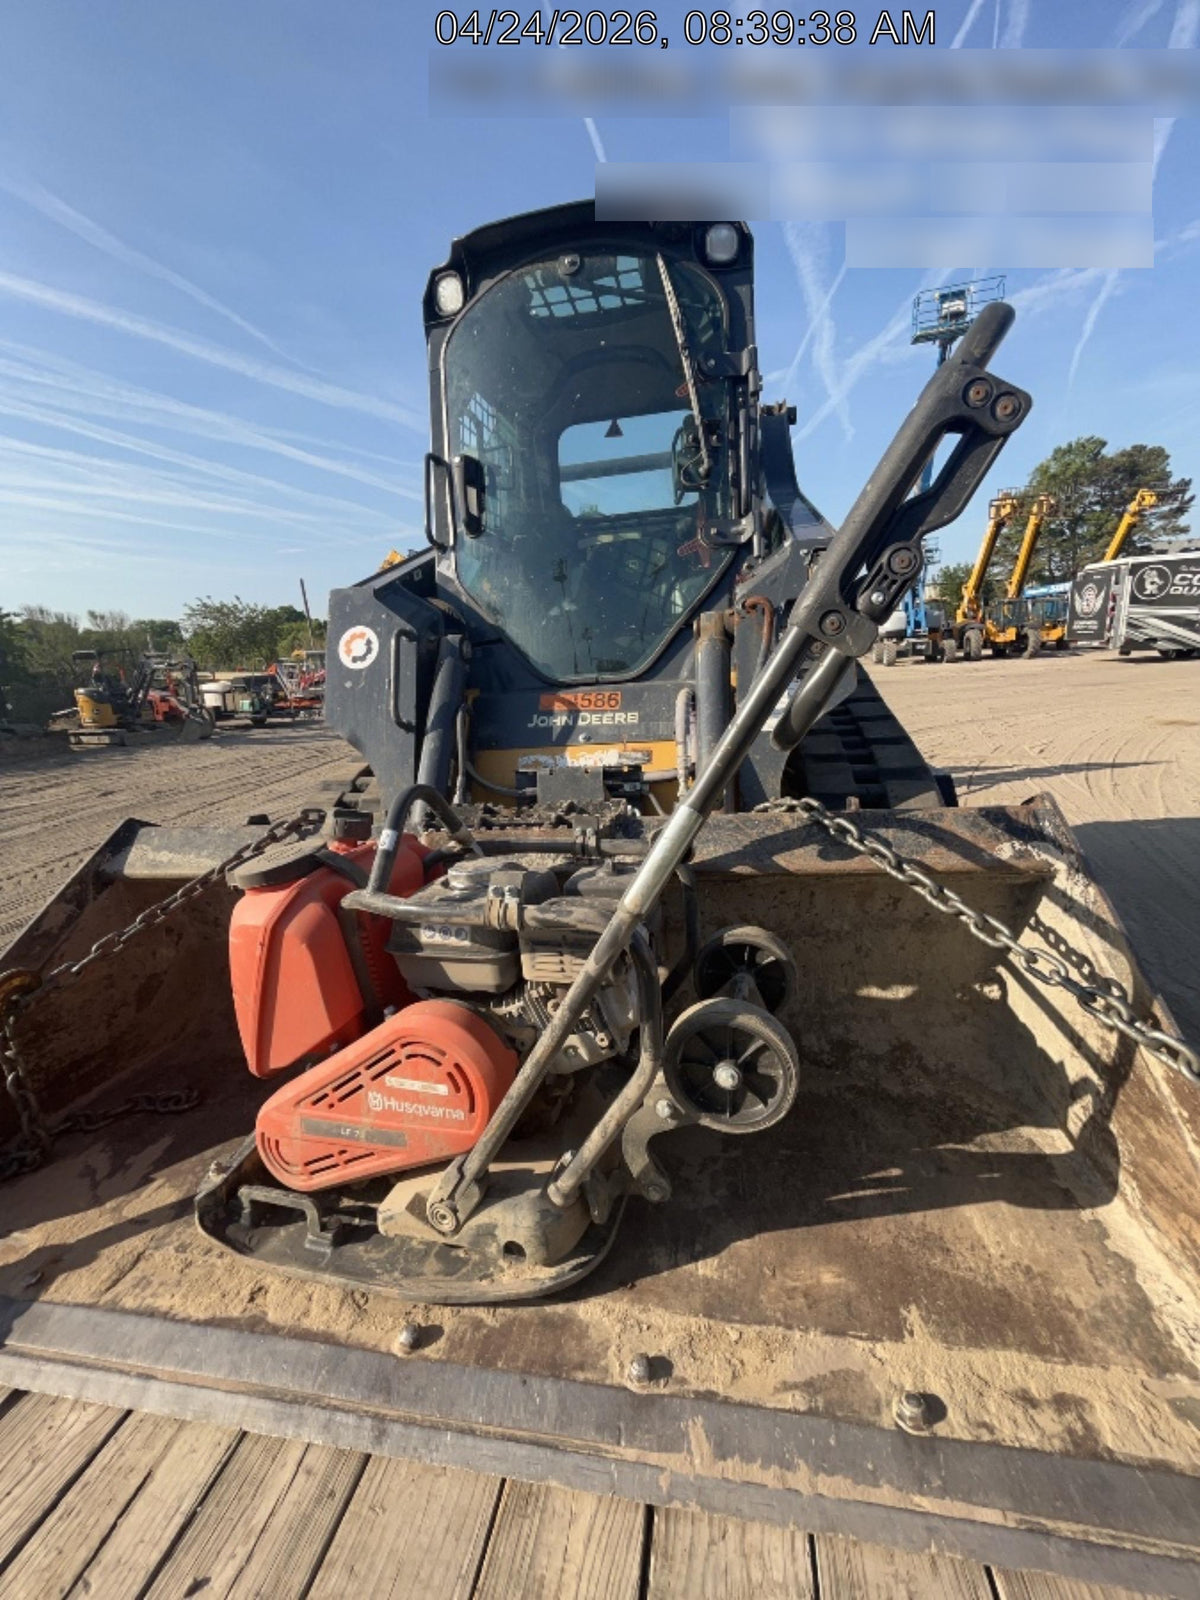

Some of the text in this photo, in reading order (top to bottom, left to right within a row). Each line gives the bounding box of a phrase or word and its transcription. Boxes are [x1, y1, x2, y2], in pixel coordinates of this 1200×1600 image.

[528, 711, 640, 728] JOHN DEERE
[383, 1096, 465, 1120] Husqvarna
